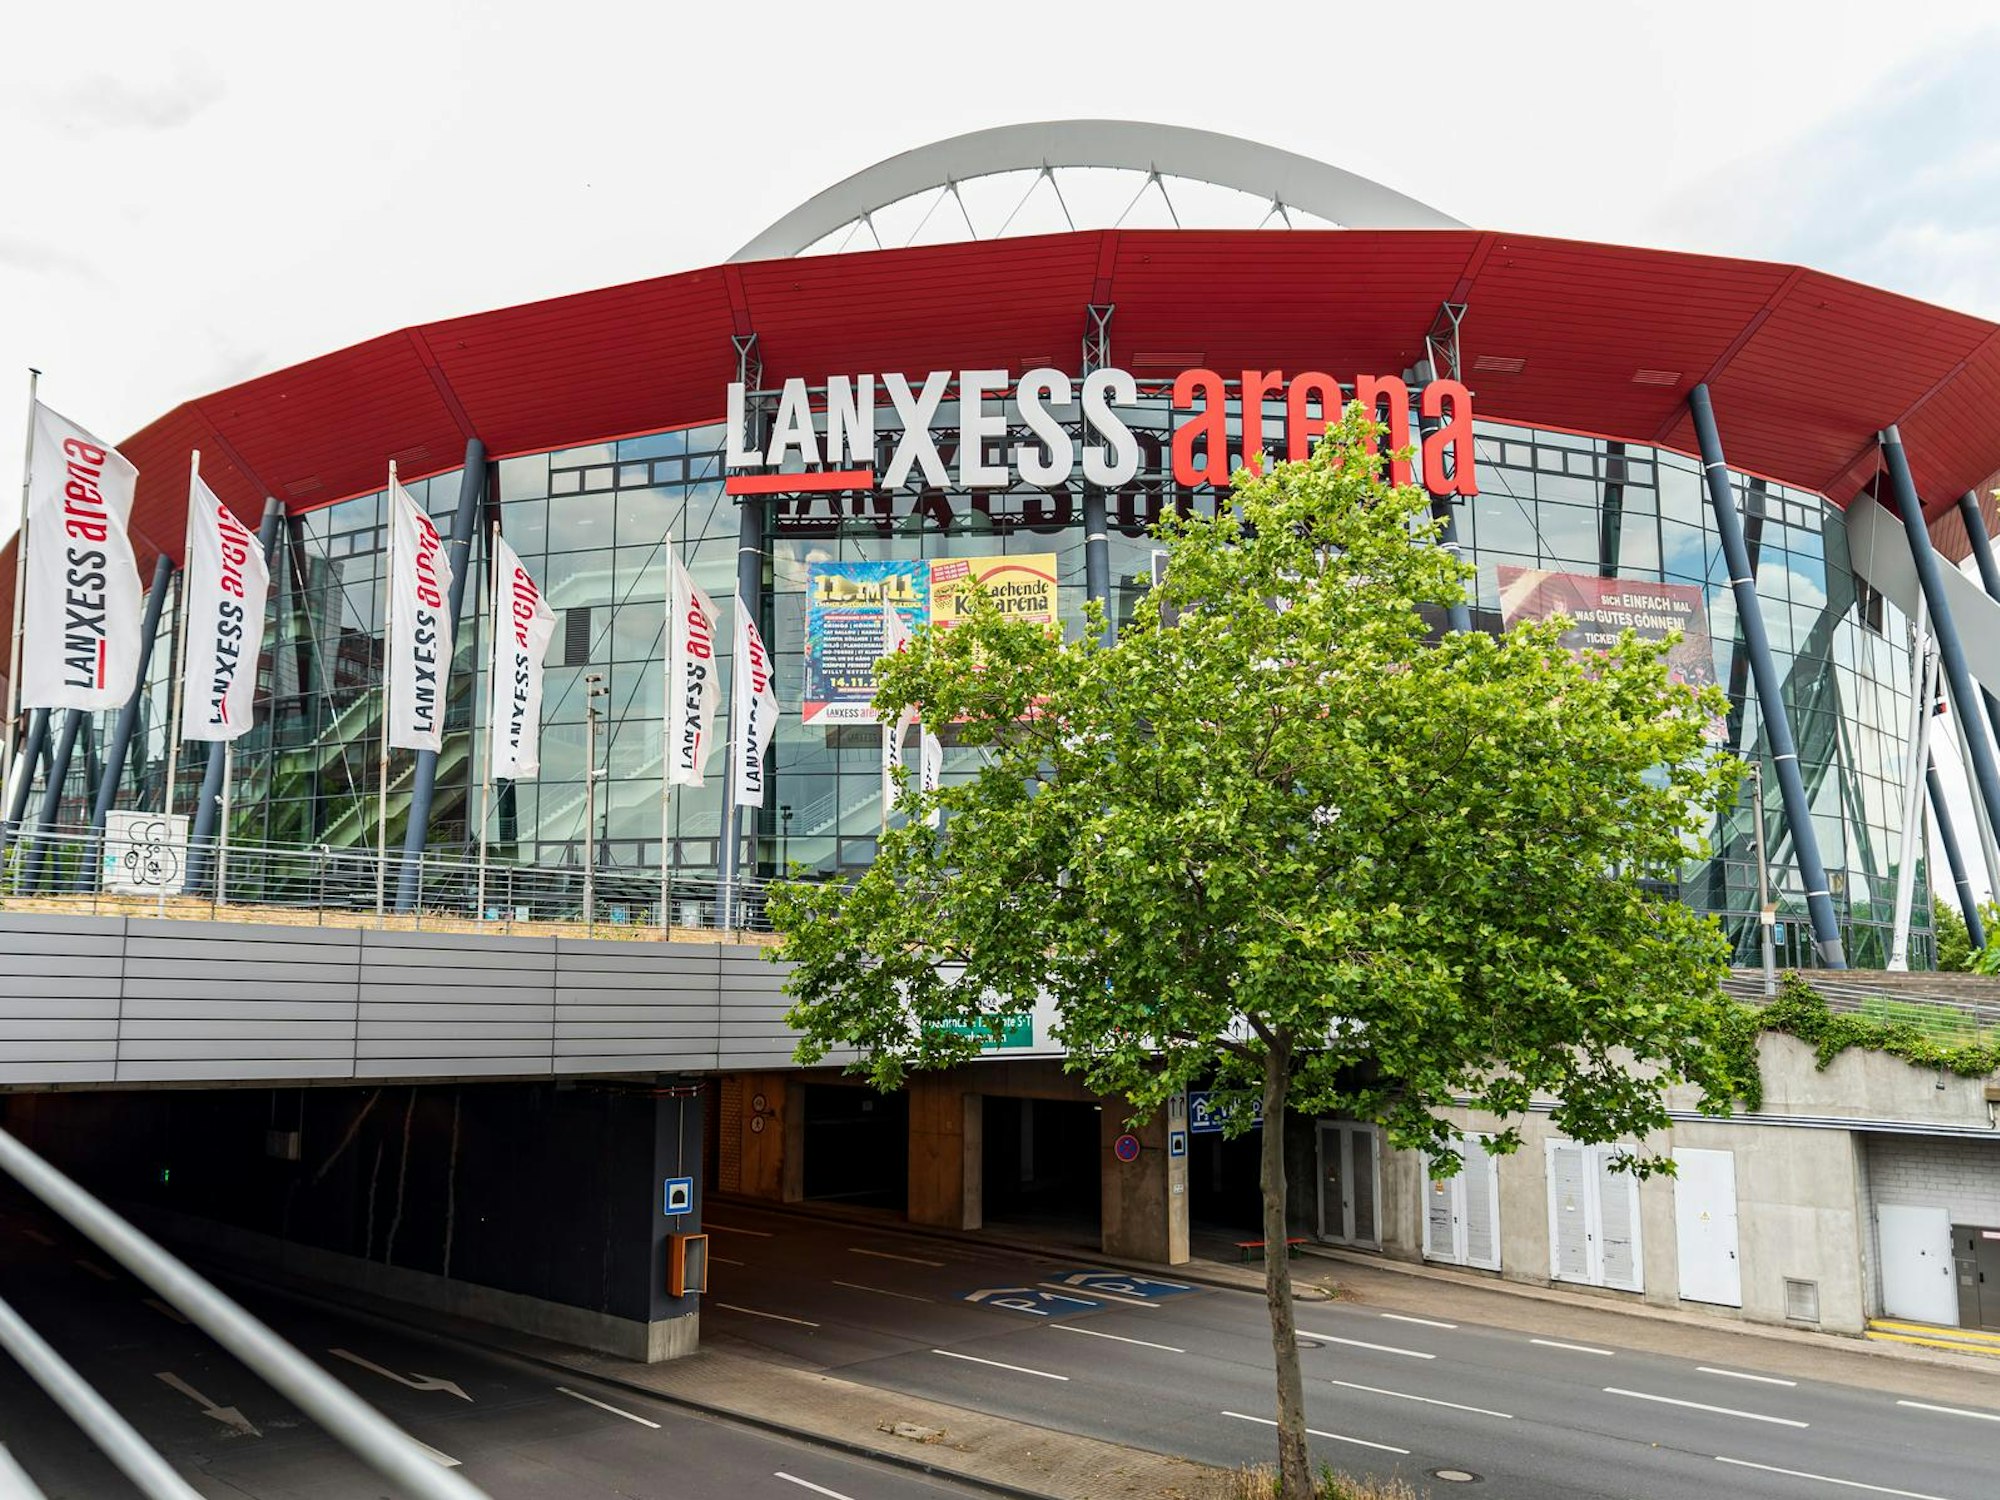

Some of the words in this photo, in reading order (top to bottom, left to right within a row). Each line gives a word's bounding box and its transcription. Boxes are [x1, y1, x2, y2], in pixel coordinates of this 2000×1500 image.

[725, 368, 1137, 490] LANXESS
[1172, 369, 1478, 496] arena
[63, 437, 107, 542] arena
[64, 548, 107, 690] LANXESS
[954, 594, 1048, 615] Karena
[988, 580, 1048, 597] achende
[1575, 610, 1595, 622] WAS
[1595, 608, 1633, 627] GUTES
[1634, 612, 1686, 630] GÖNNEN!
[1601, 595, 1620, 606] SICH
[1623, 594, 1670, 611] EINFACH
[1673, 600, 1692, 613] MAL
[209, 600, 244, 725] LANXESS
[413, 610, 437, 733] LANXESS
[510, 653, 529, 762] ANXESS
[826, 708, 859, 719] LANXESS
[860, 707, 882, 719] aren
